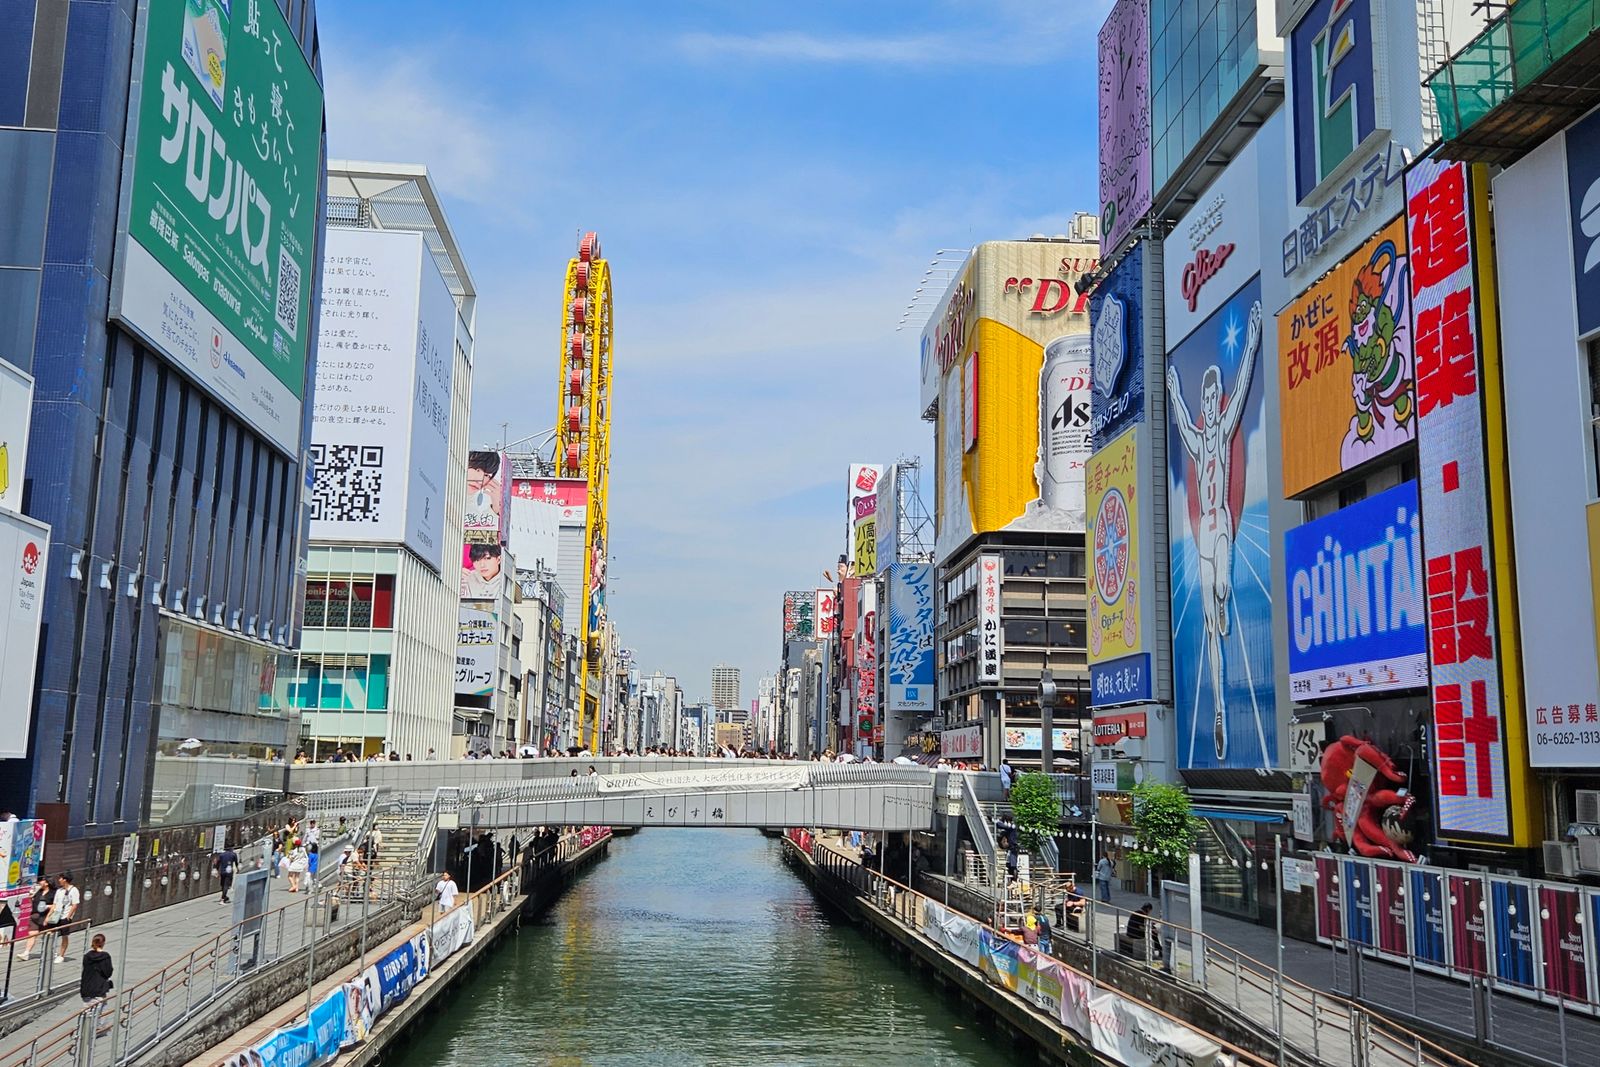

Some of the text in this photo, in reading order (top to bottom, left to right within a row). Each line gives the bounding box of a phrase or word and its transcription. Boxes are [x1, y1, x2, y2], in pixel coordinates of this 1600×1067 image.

[160, 61, 272, 282] サロンパス
[182, 244, 210, 282] Salonpas
[1182, 243, 1235, 312] Glico
[1291, 293, 1334, 340] かぜに
[1288, 316, 1340, 390] 改源
[518, 482, 557, 495] 免税
[1206, 453, 1217, 532] グリコ
[1408, 161, 1499, 799] 建築・設計
[857, 524, 866, 574] バイト
[866, 521, 876, 573] 高収入
[902, 565, 933, 650] シャッターは
[985, 574, 996, 615] 本場の味
[985, 618, 997, 676] かに道楽
[1094, 723, 1121, 736] LOTTERIA
[1536, 703, 1598, 725] 広告募集
[1537, 731, 1600, 745] 06-6262-1313
